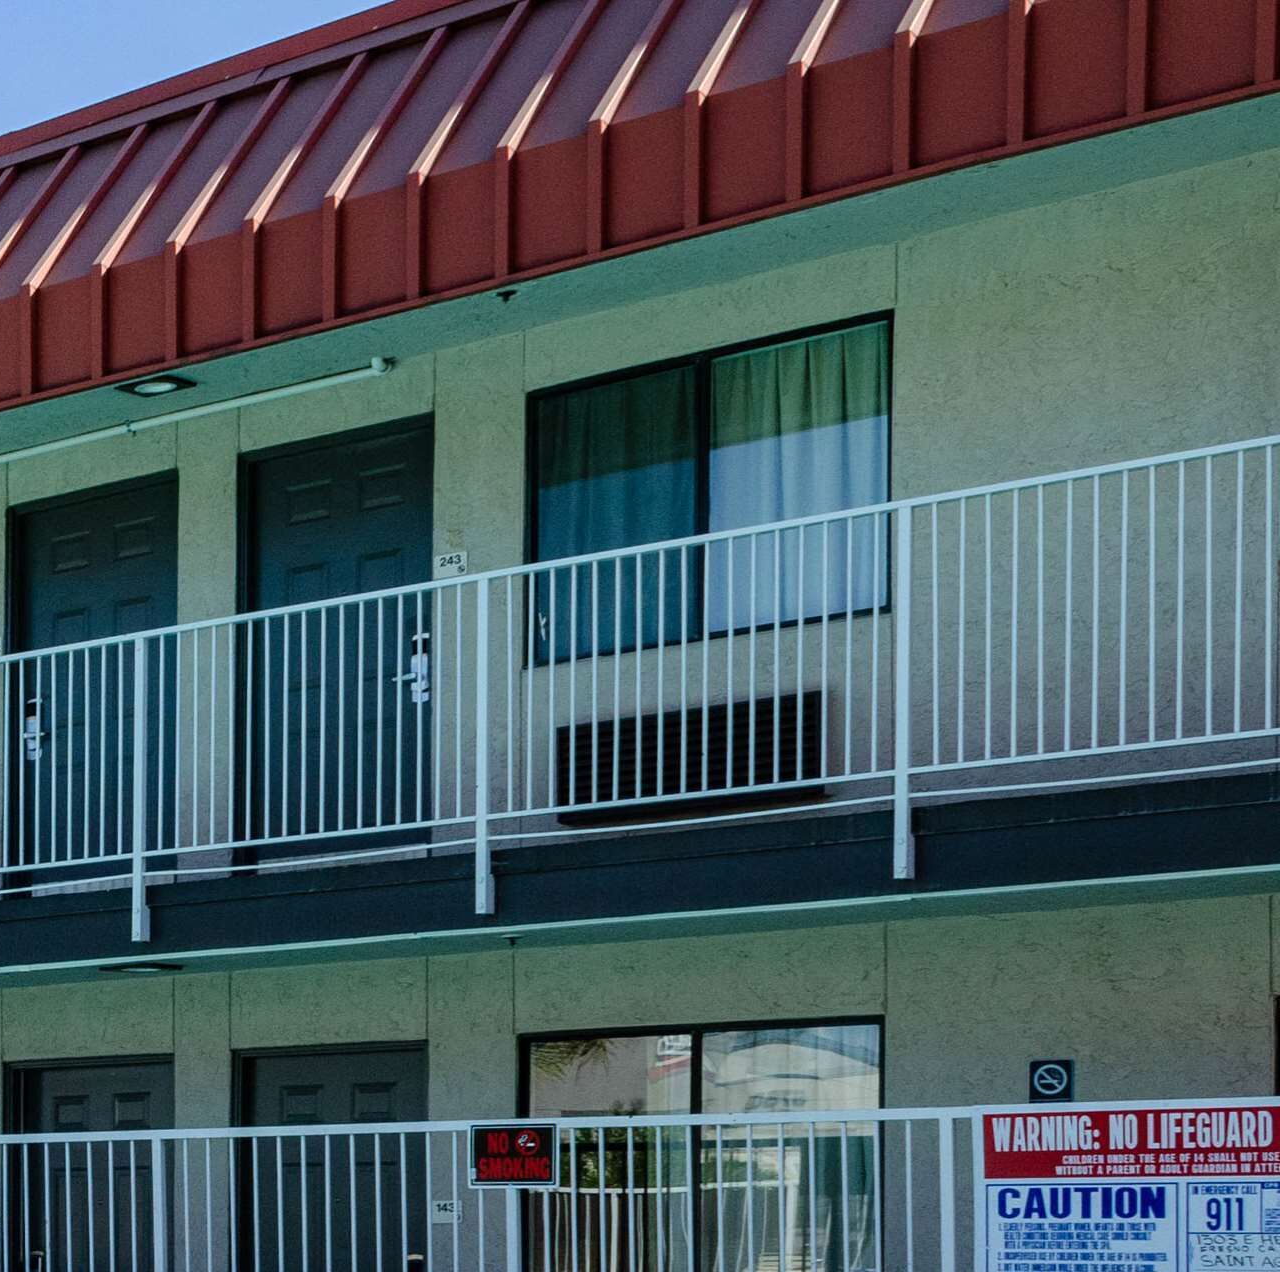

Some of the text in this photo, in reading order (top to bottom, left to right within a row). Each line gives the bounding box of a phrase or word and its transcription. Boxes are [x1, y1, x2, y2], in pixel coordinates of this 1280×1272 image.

[439, 554, 461, 567] 243
[991, 1111, 1273, 1152] WARNING: NO LIFEGUARD
[487, 1132, 509, 1154] NO
[479, 1156, 550, 1180] SMOKING
[1139, 1153, 1155, 1163] THE
[1158, 1153, 1177, 1163] AGE
[1179, 1153, 1191, 1163] OF
[1207, 1152, 1236, 1162] SHALL
[1240, 1152, 1258, 1162] NOT
[1097, 1166, 1104, 1175] A
[997, 1186, 1166, 1219] CAUTION
[1206, 1197, 1244, 1231] 911
[1200, 1254, 1255, 1267] SAINT
